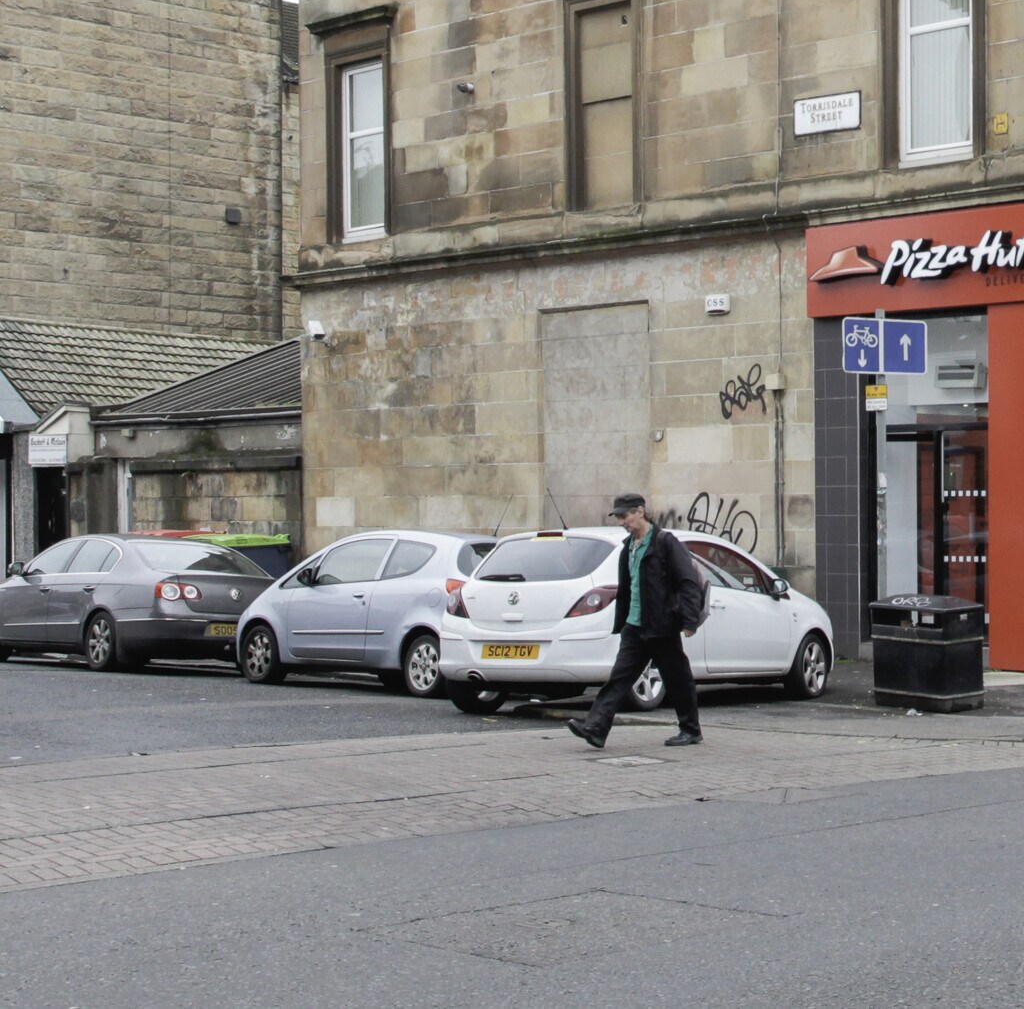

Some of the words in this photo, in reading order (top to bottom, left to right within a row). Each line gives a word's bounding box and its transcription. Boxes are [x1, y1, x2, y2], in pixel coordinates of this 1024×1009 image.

[800, 97, 854, 114] TORRISDALE
[810, 110, 843, 124] STREET
[880, 237, 968, 285] Pizza
[488, 646, 511, 657] SC12
[513, 645, 534, 656] TGV
